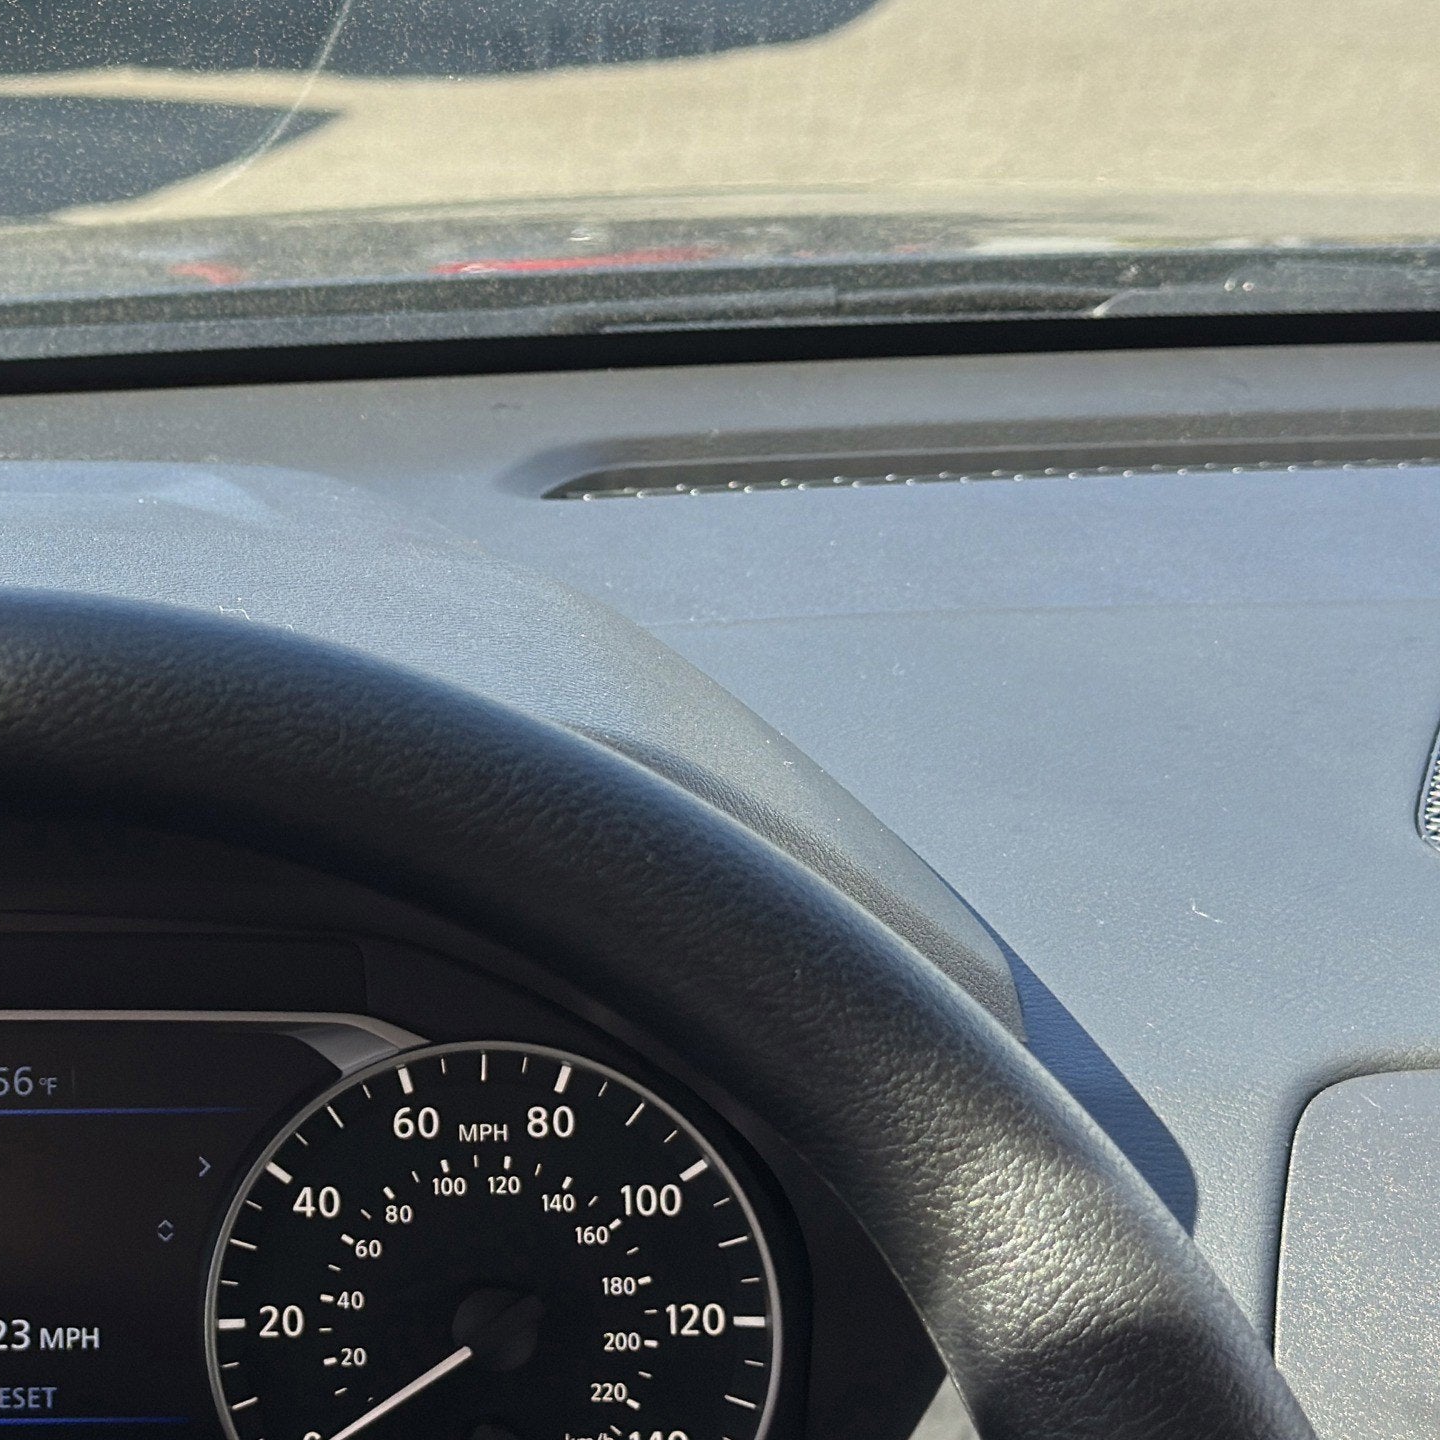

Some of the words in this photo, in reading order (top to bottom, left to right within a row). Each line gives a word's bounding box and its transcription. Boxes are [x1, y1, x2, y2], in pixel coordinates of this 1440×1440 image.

[393, 1106, 439, 1139] 60
[526, 1106, 575, 1139] 80
[458, 1123, 509, 1143] MPH
[432, 1177, 467, 1196] 100
[487, 1176, 521, 1195] 120
[292, 1186, 341, 1218] 40
[542, 1194, 575, 1213] 140
[621, 1184, 682, 1217] 100
[385, 1205, 413, 1224] 80
[575, 1226, 609, 1245] 160
[355, 1239, 382, 1259] 60
[602, 1277, 636, 1295] 180
[337, 1291, 365, 1310] 40
[259, 1305, 305, 1337] 20
[665, 1303, 725, 1337] 120
[40, 1328, 100, 1350] MPH
[603, 1332, 641, 1351] 200
[341, 1347, 367, 1367] 20
[591, 1383, 627, 1401] 220
